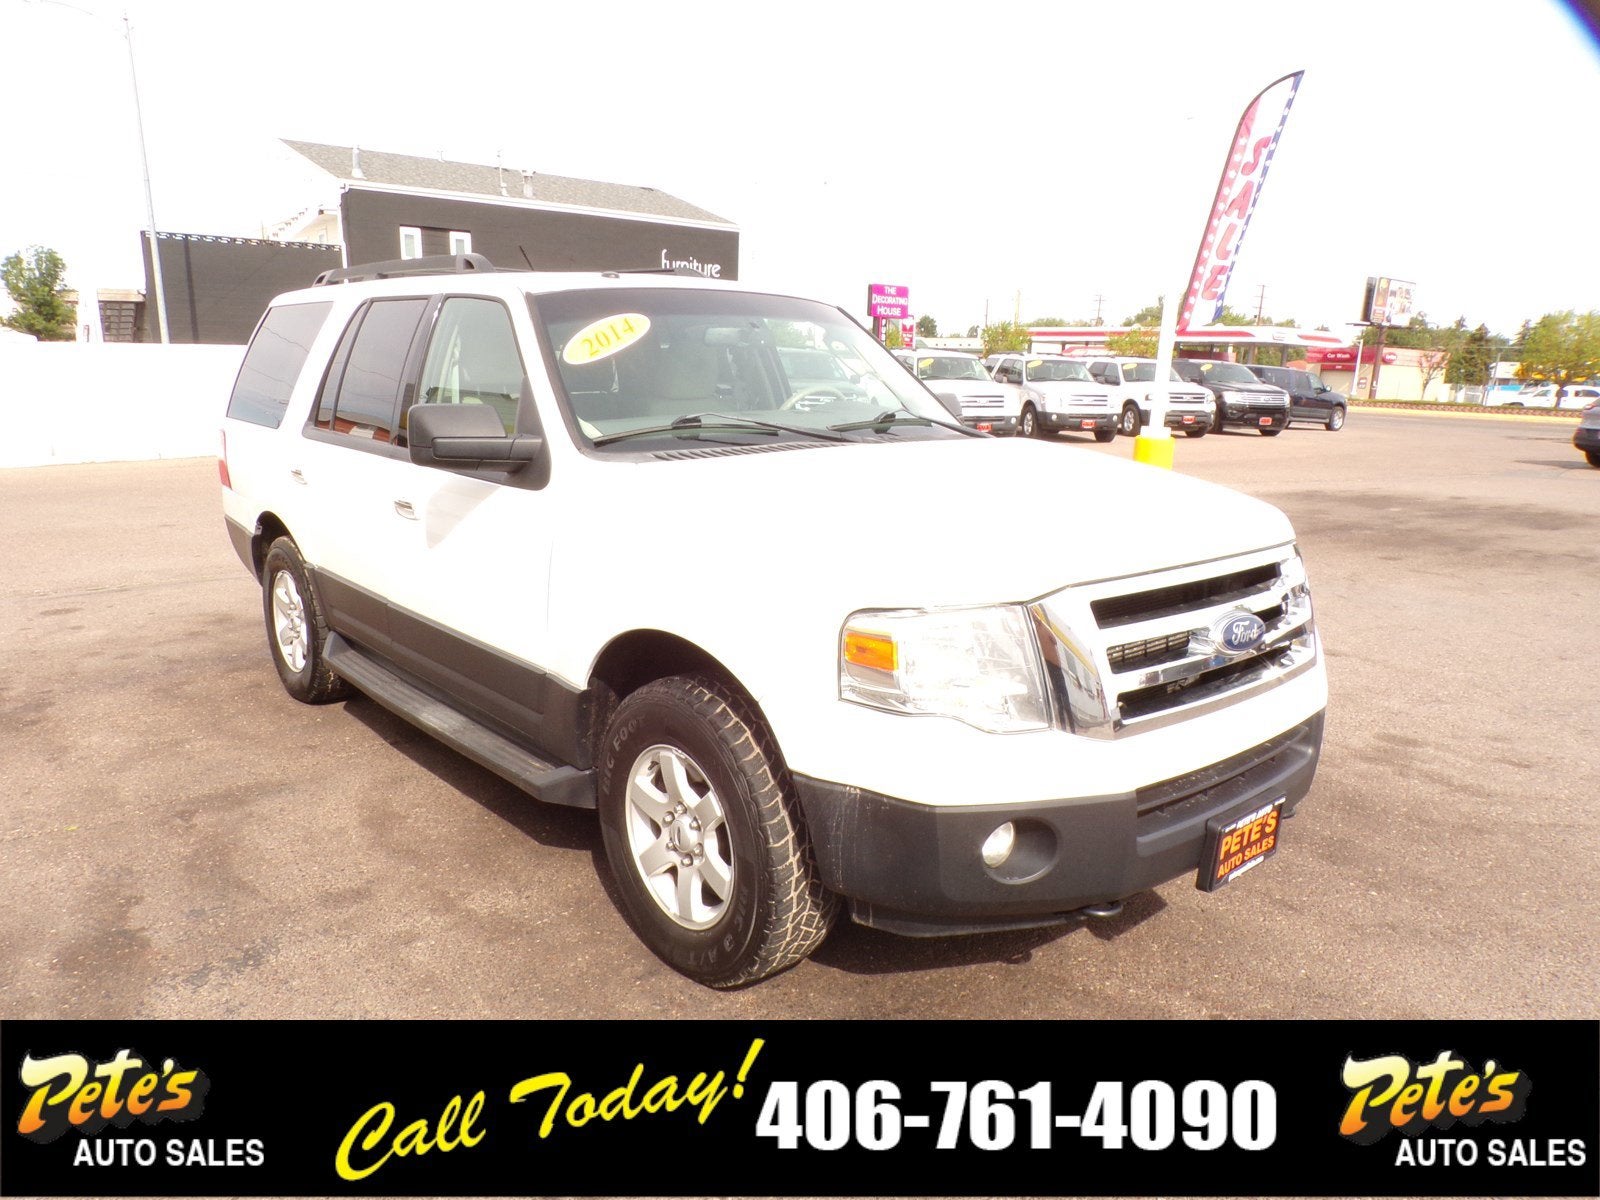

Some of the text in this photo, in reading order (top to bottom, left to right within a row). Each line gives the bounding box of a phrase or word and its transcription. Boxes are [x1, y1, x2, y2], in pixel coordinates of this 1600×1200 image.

[1201, 135, 1272, 301] SALE
[661, 248, 721, 278] furniture
[884, 286, 897, 295] THE
[877, 305, 902, 317] HOUSE
[581, 317, 634, 357] 2014
[1231, 620, 1259, 646] Ford
[1220, 810, 1278, 860] PETE'S
[1217, 853, 1243, 879] AUTO
[1244, 835, 1275, 861] SALES
